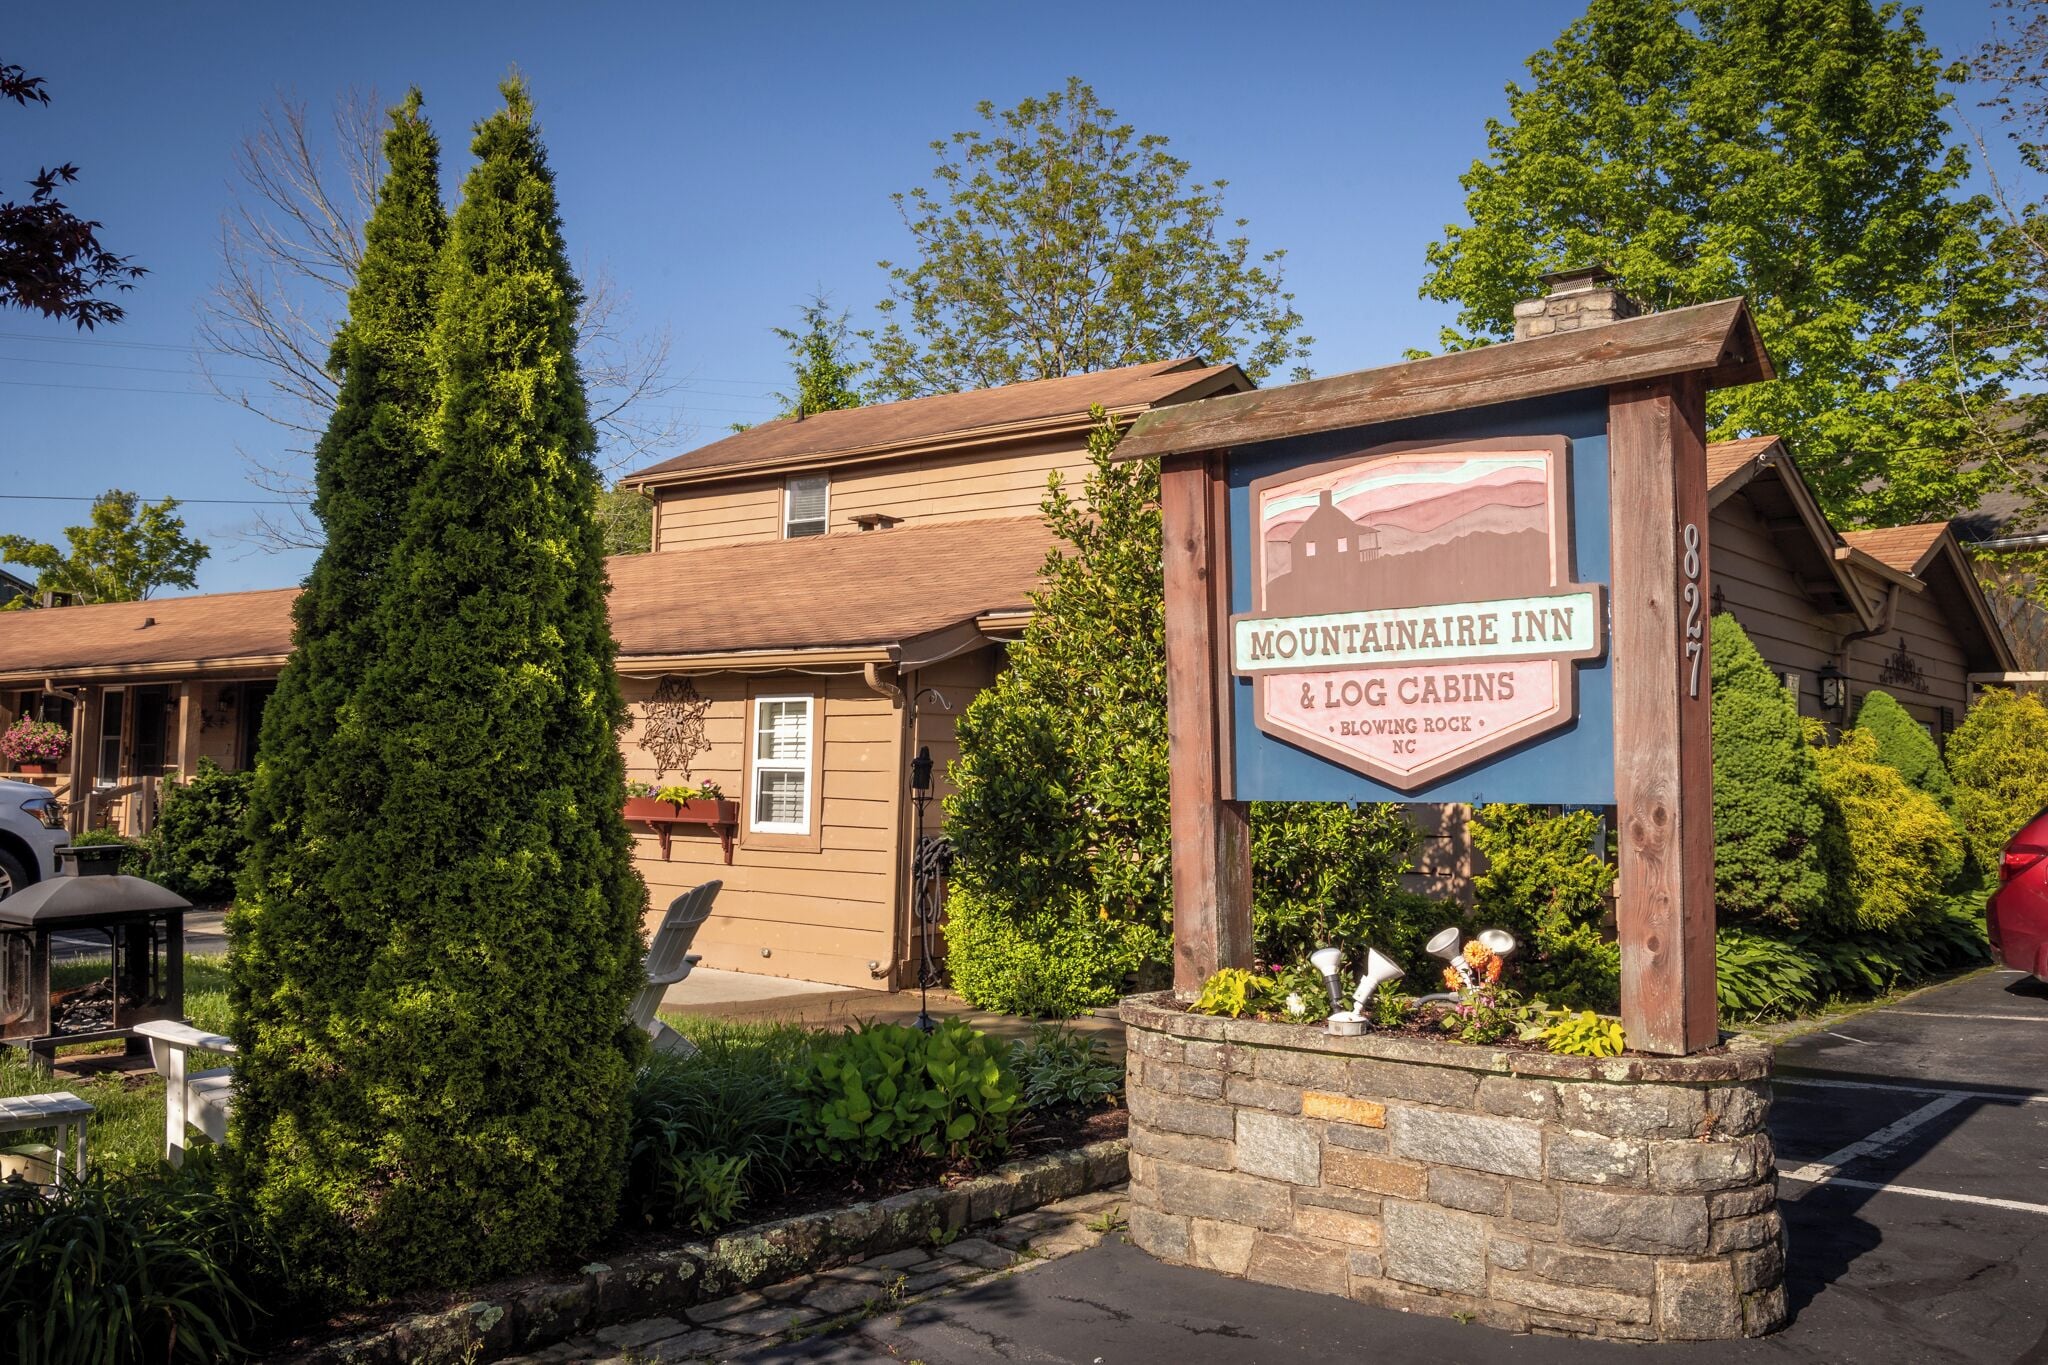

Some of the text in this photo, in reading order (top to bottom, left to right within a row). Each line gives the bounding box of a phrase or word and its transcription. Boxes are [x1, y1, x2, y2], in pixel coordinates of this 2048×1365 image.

[1684, 523, 1702, 697] 827
[1250, 607, 1574, 661] MOUNTAINAIRE INN
[1300, 671, 1515, 709] & LOG CABINS
[1340, 715, 1473, 737] BLOWING ROCK
[1392, 739, 1417, 755] NC
